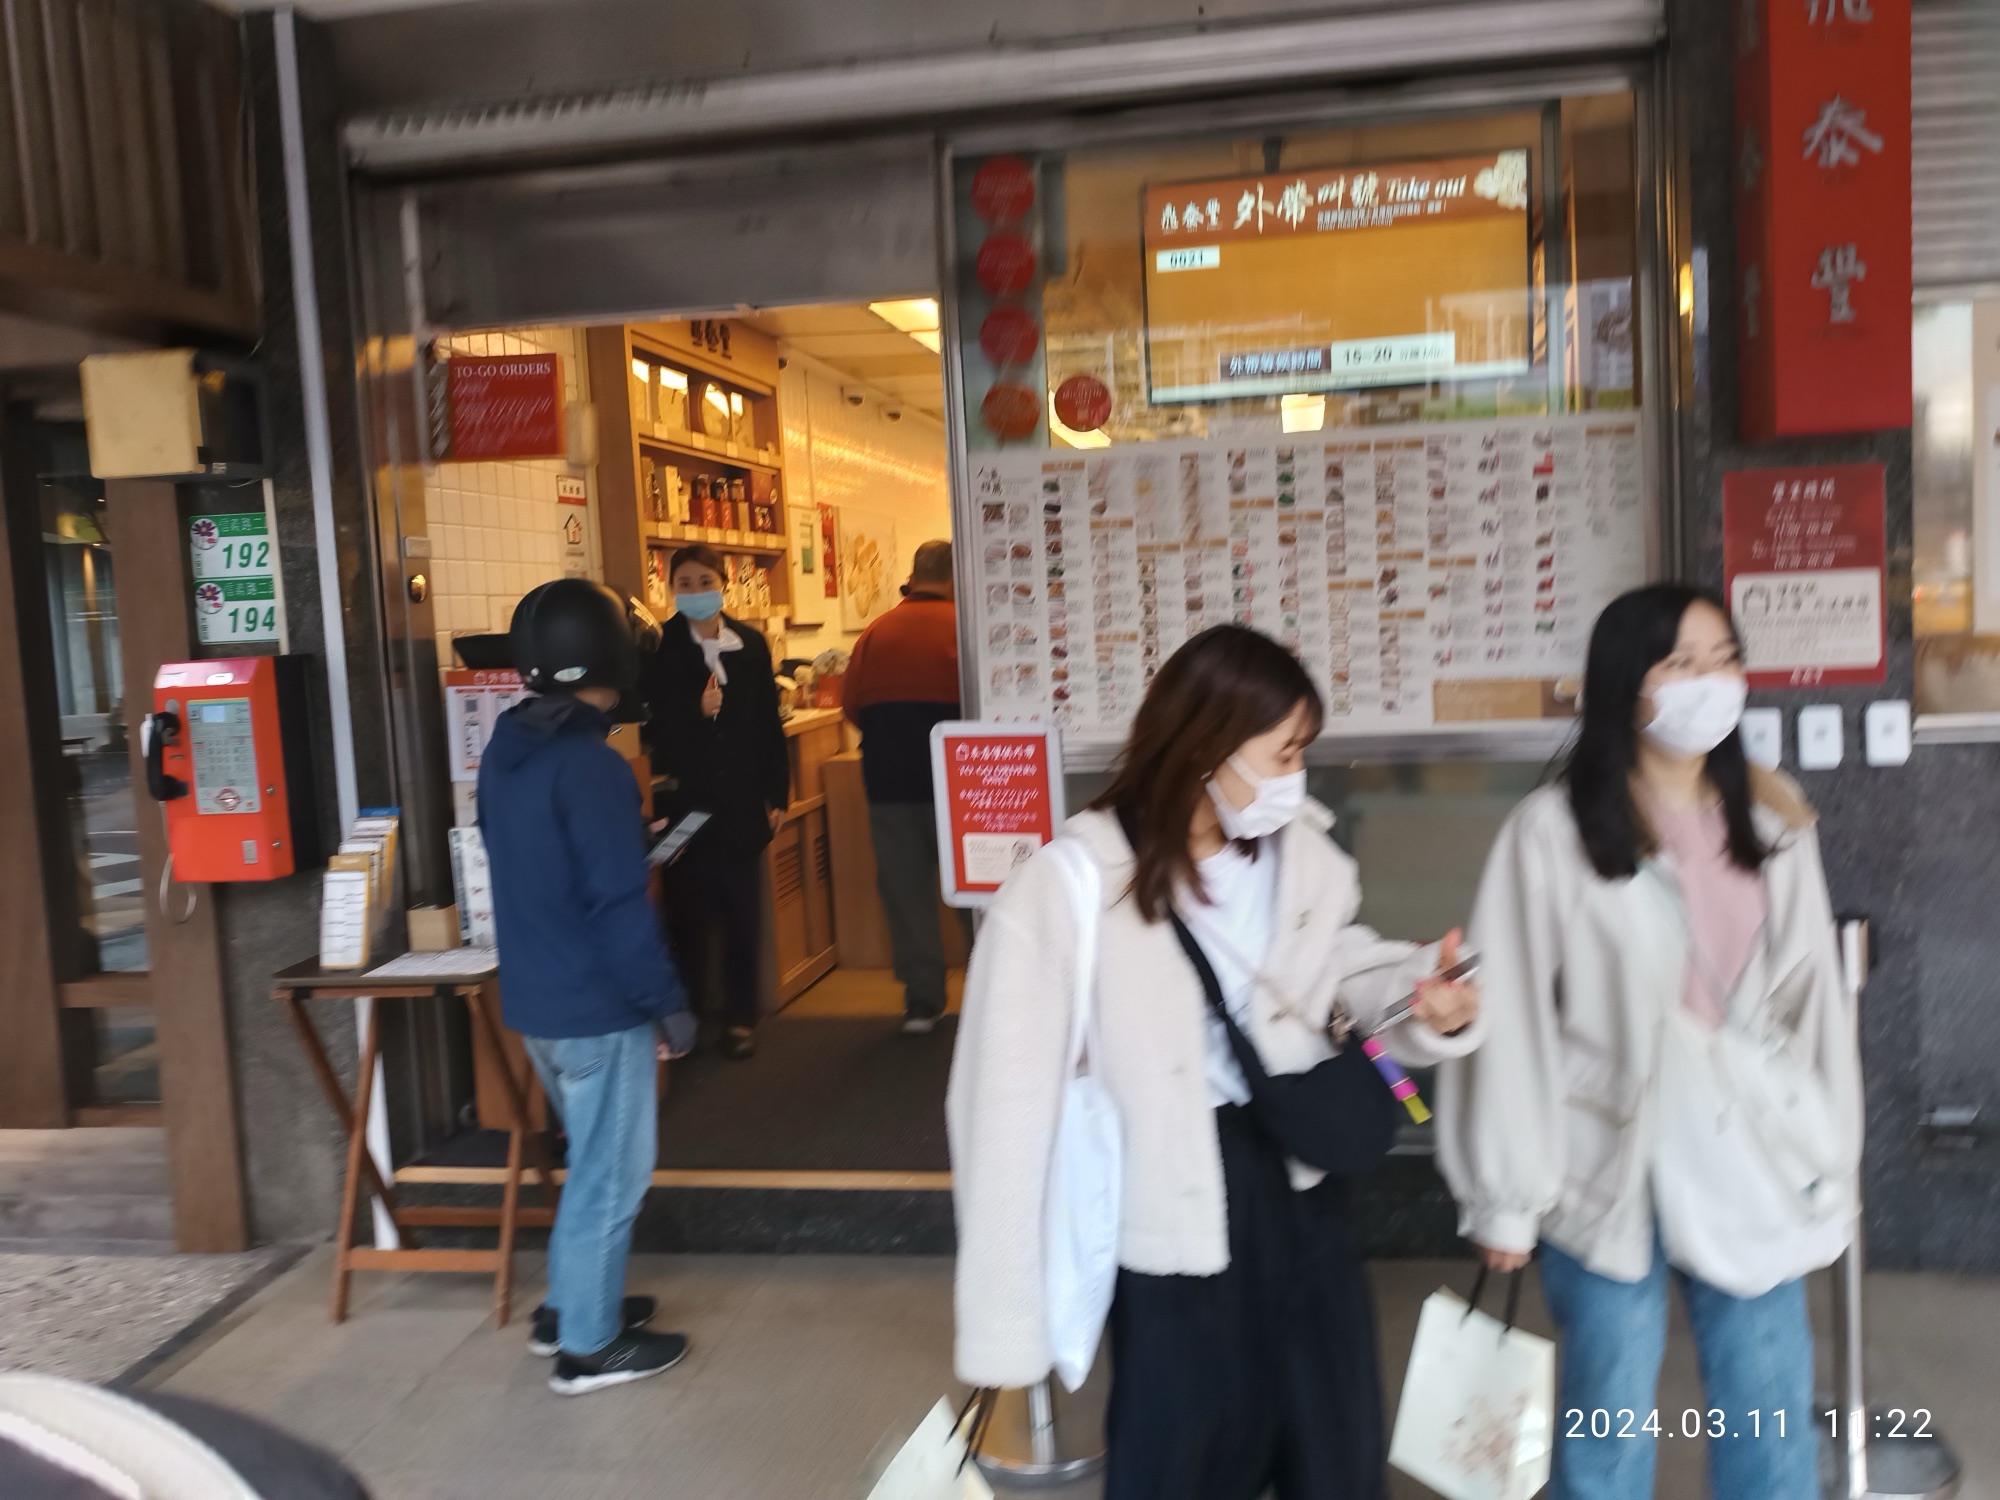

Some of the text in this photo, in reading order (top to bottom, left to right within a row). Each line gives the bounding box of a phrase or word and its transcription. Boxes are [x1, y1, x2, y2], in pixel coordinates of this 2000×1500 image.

[1233, 171, 1379, 234] 外帶叫號
[1386, 176, 1430, 203] Take
[1434, 174, 1466, 199] out
[1170, 250, 1203, 269] 0021
[455, 362, 551, 378] TO-GO ORDERS
[222, 541, 269, 569] 192
[228, 606, 276, 633] 194
